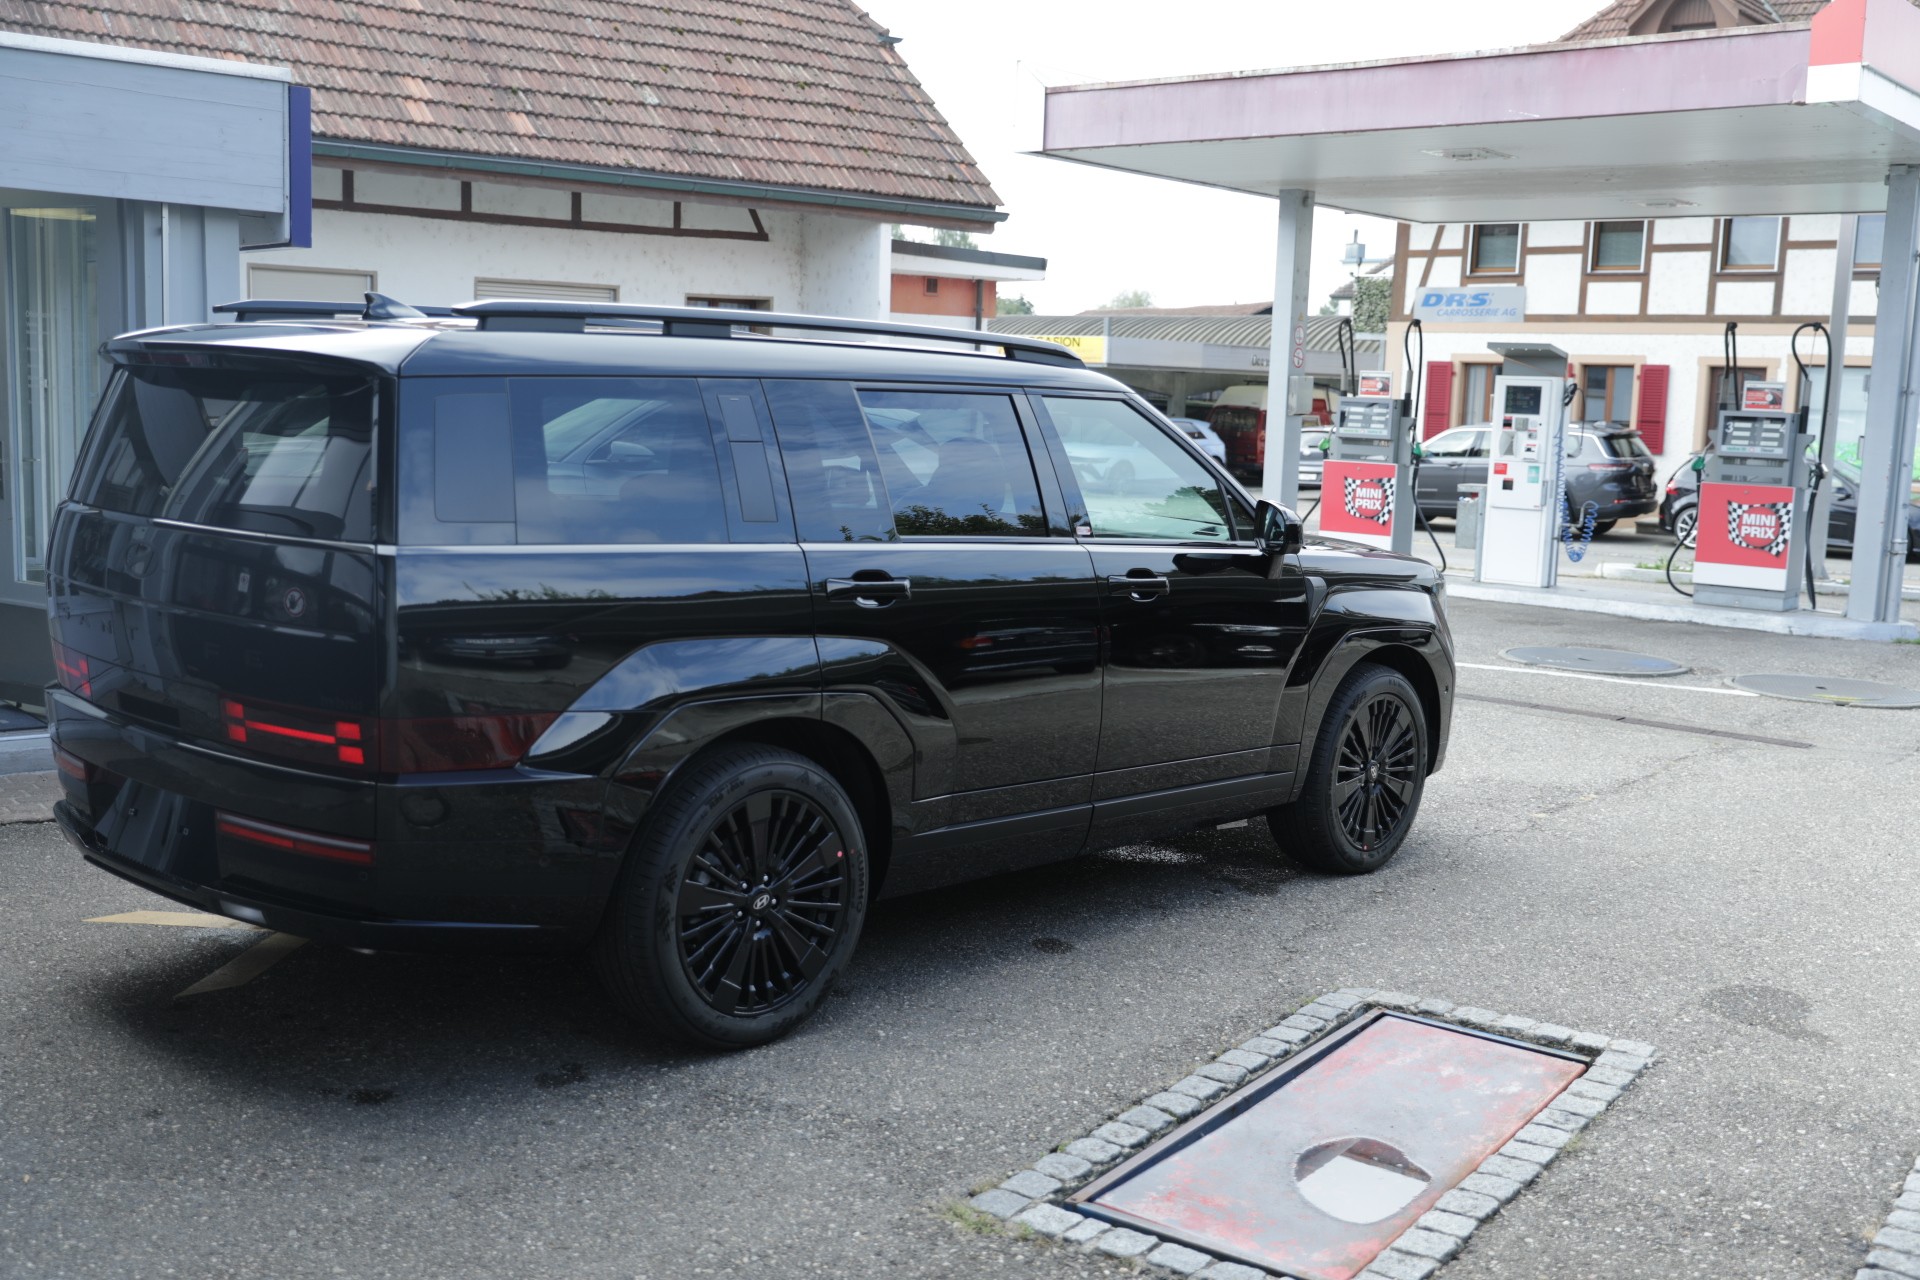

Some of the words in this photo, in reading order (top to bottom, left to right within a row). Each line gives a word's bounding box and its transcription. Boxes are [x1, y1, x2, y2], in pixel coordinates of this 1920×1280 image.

[1421, 291, 1491, 307] DRS
[1436, 308, 1499, 317] CARROSSERIE
[1502, 307, 1518, 316] AG
[1724, 421, 1734, 433] 3
[1355, 487, 1383, 499] MINI
[1354, 498, 1383, 510] PRIX
[1742, 513, 1777, 527] MINI
[1740, 526, 1776, 540] PRIX
